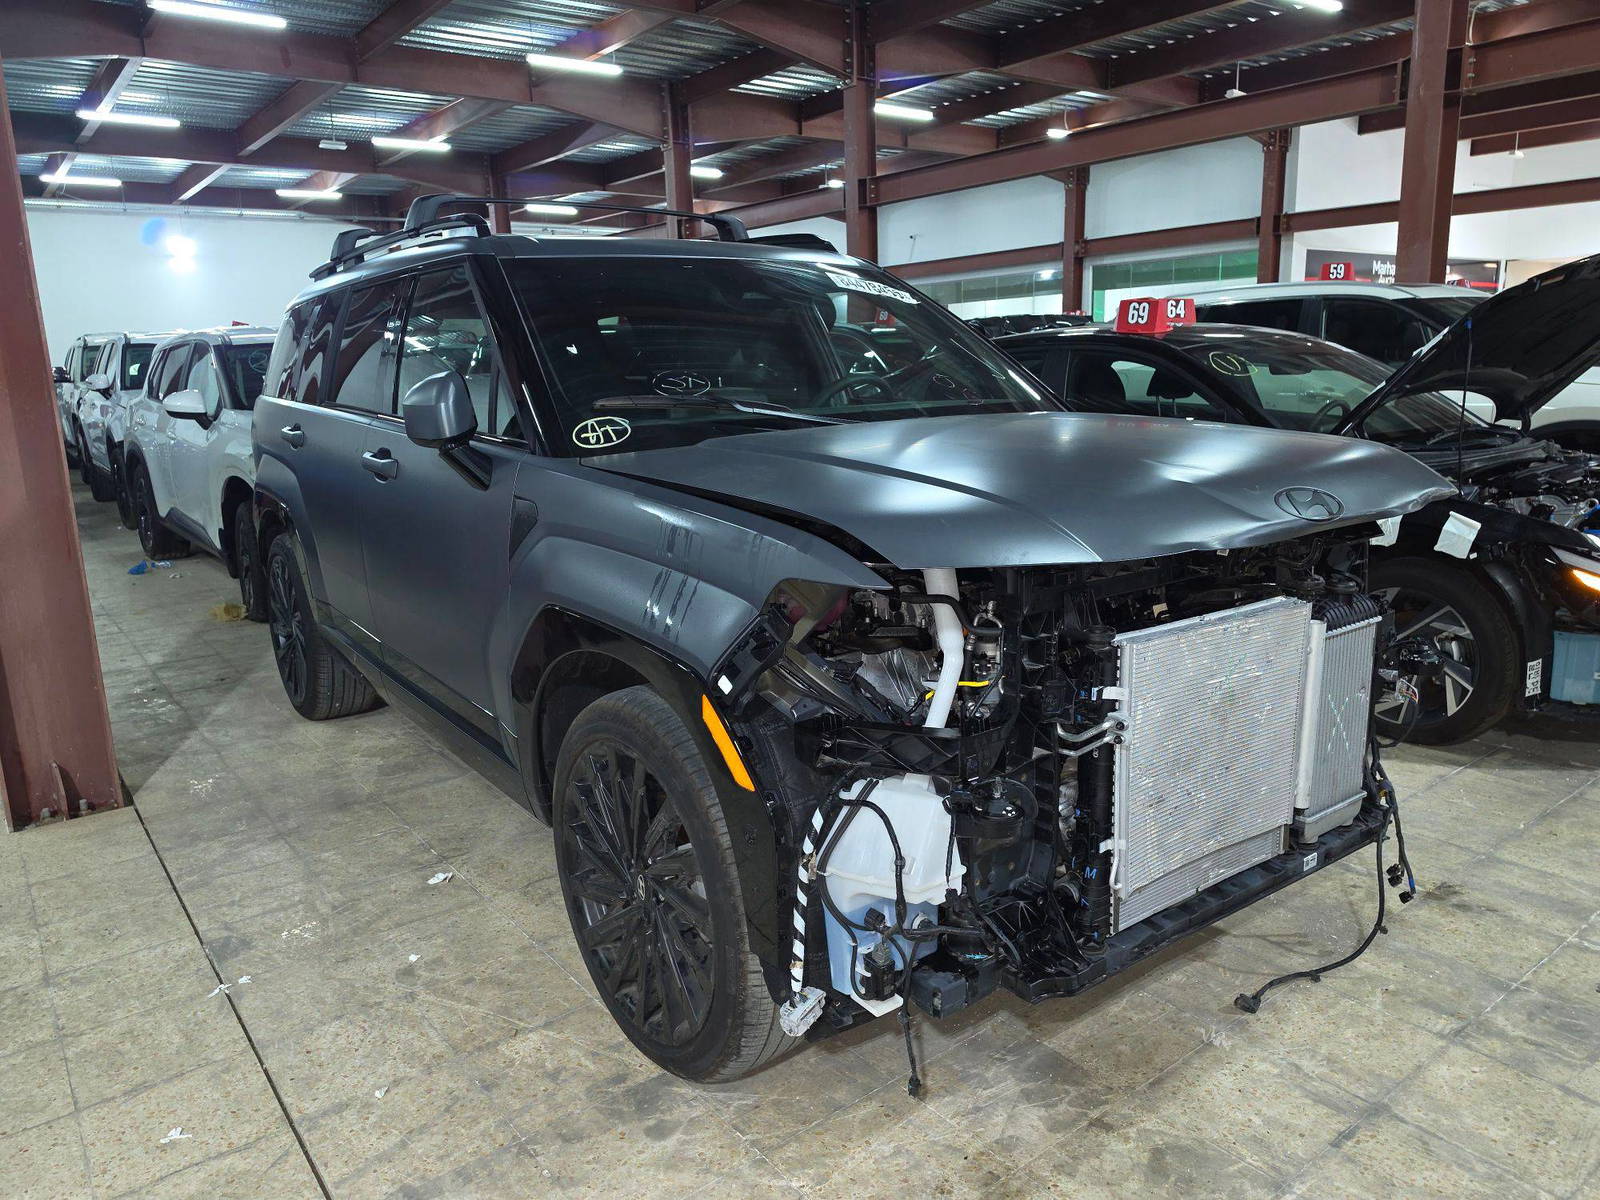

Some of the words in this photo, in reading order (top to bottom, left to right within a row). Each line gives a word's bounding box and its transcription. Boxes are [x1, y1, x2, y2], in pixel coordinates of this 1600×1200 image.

[1329, 263, 1345, 280] 59
[1127, 301, 1150, 325] 69
[1167, 299, 1186, 319] 64
